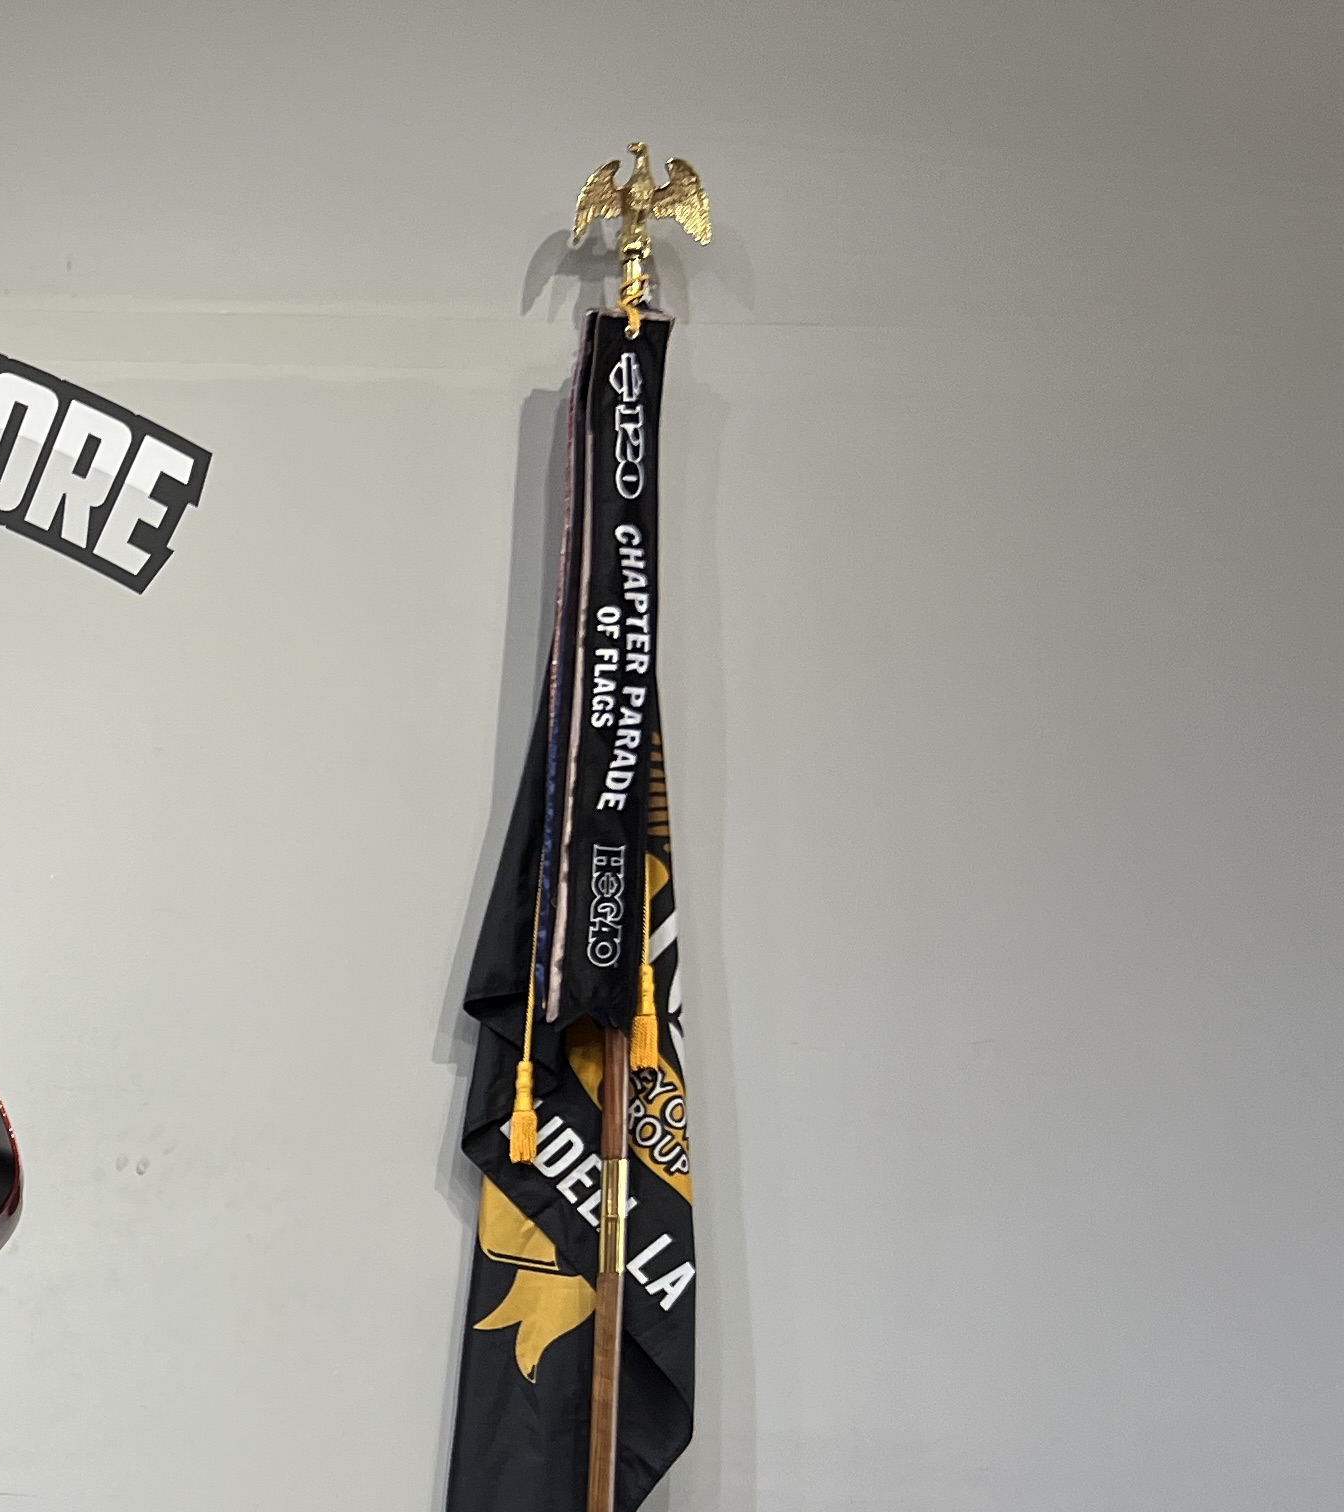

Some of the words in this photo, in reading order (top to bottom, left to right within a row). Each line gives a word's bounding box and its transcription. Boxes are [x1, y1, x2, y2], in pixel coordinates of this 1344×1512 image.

[614, 404, 646, 499] 120
[595, 606, 620, 638] OF
[614, 524, 651, 675] CHAPTER
[590, 647, 619, 729] FLAGS
[596, 686, 647, 812] PARADE
[628, 1098, 690, 1174] ROUP
[626, 1233, 696, 1311] LA
